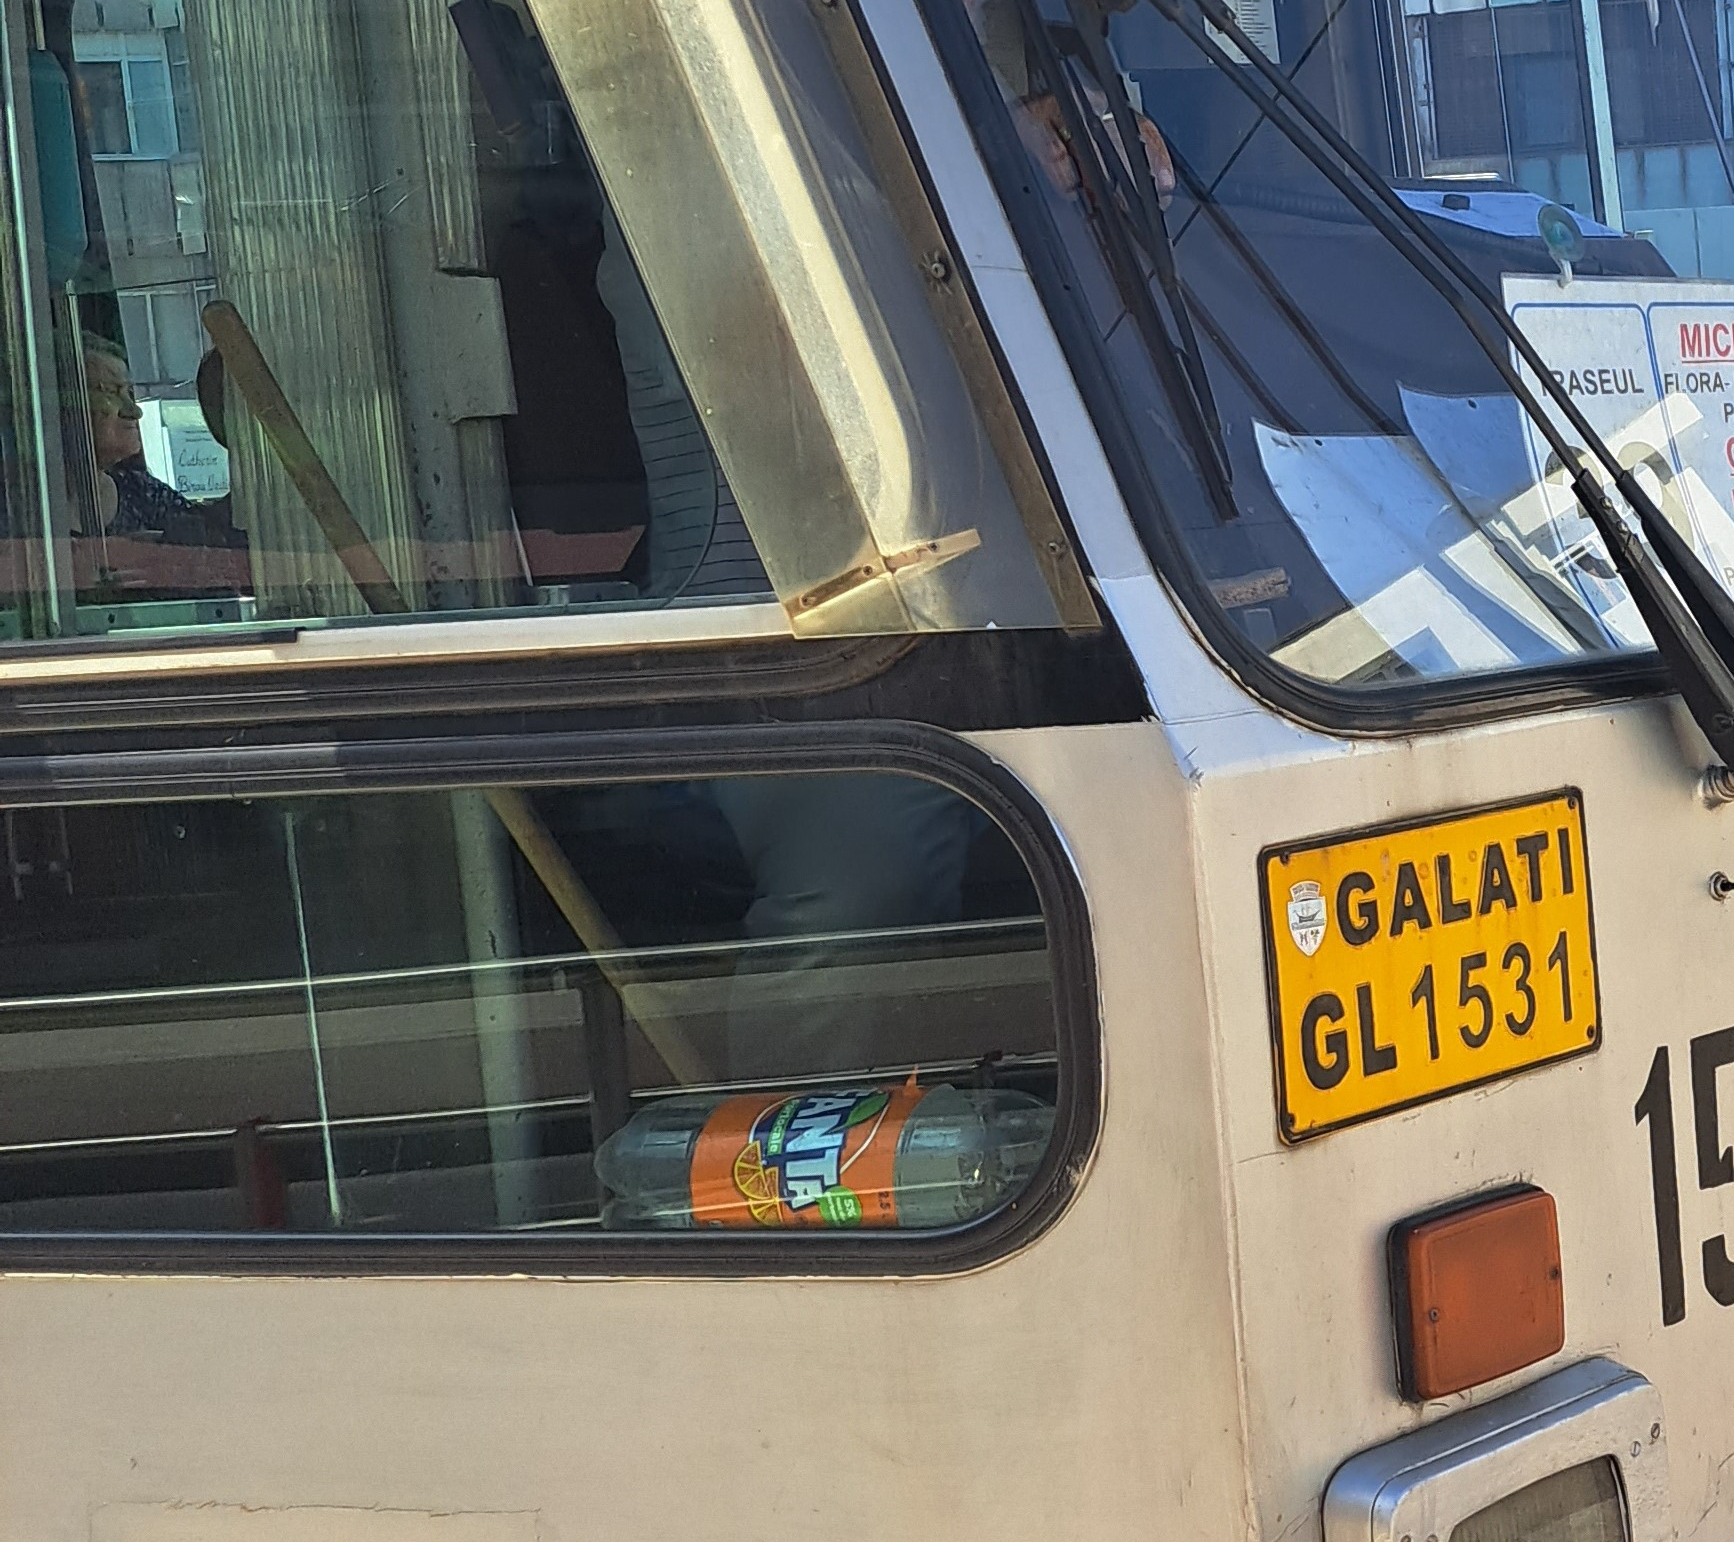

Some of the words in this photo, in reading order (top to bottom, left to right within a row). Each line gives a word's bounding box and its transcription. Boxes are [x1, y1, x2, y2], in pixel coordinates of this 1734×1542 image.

[1336, 827, 1575, 947] GALATI
[1301, 984, 1396, 1090] GL
[1411, 930, 1574, 1061] 1531
